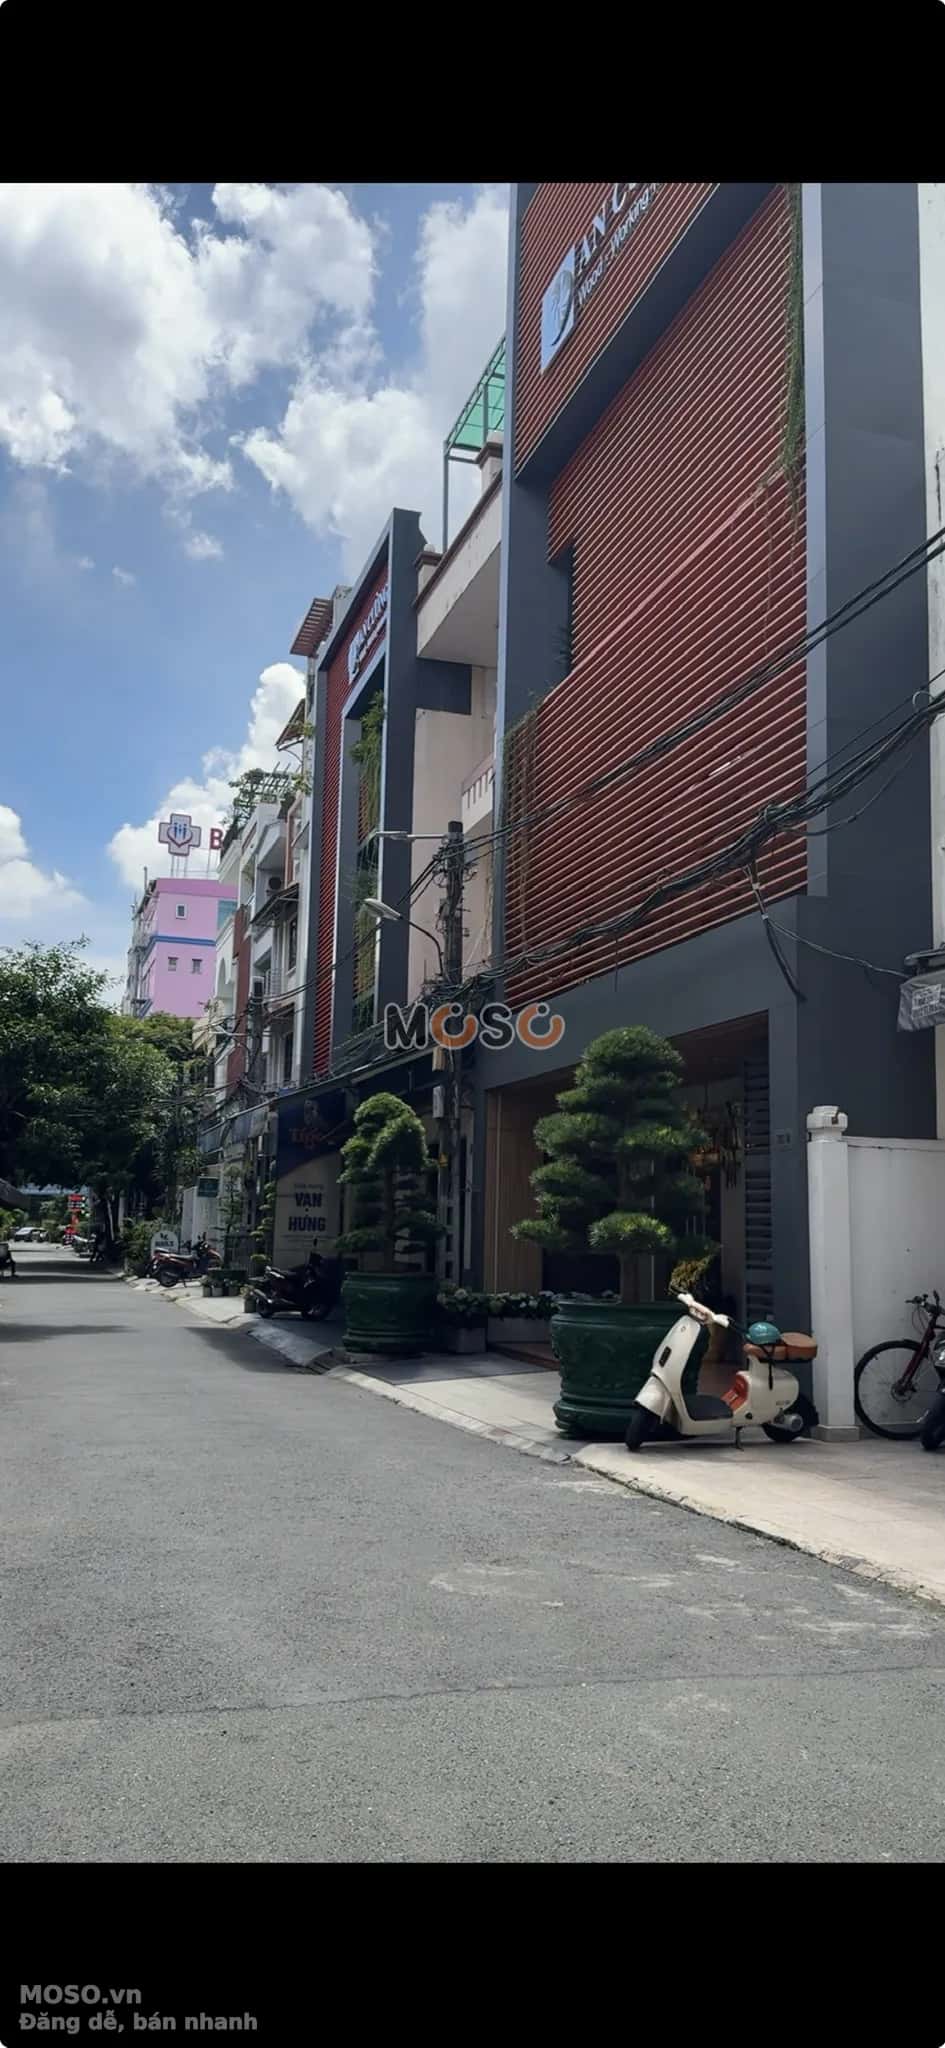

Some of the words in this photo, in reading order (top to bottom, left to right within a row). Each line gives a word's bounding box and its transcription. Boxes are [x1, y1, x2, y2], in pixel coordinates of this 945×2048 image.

[577, 200, 607, 277] AN
[578, 254, 604, 305] Wood
[609, 187, 650, 257] Working
